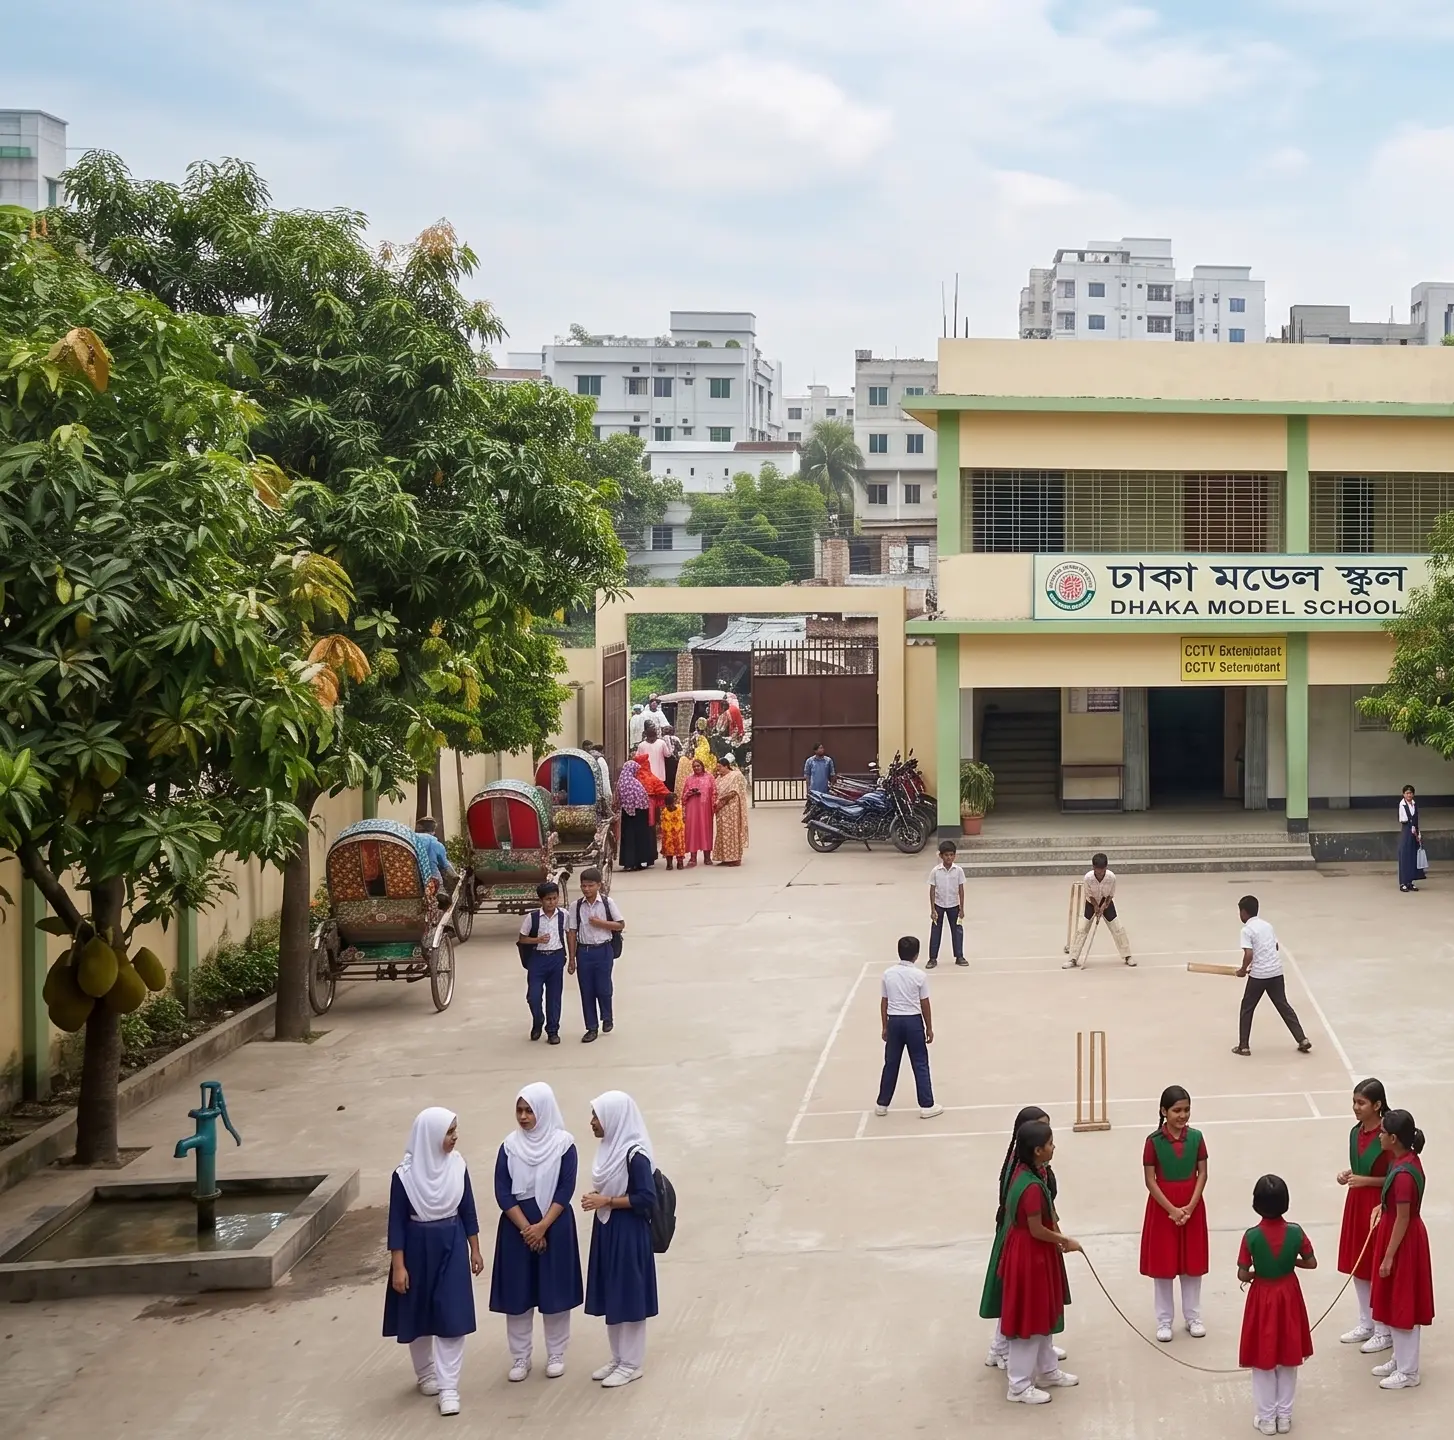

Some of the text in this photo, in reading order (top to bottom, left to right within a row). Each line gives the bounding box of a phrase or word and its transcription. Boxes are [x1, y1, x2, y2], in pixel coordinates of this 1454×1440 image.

[1106, 561, 1198, 592] ঢাকা
[1209, 566, 1324, 592] মডেল
[1335, 566, 1408, 596] স্কুল
[1111, 600, 1404, 615] DHAKA MODEL SCHOOL
[1184, 644, 1216, 657] CCTV
[1184, 661, 1216, 673] CCTV
